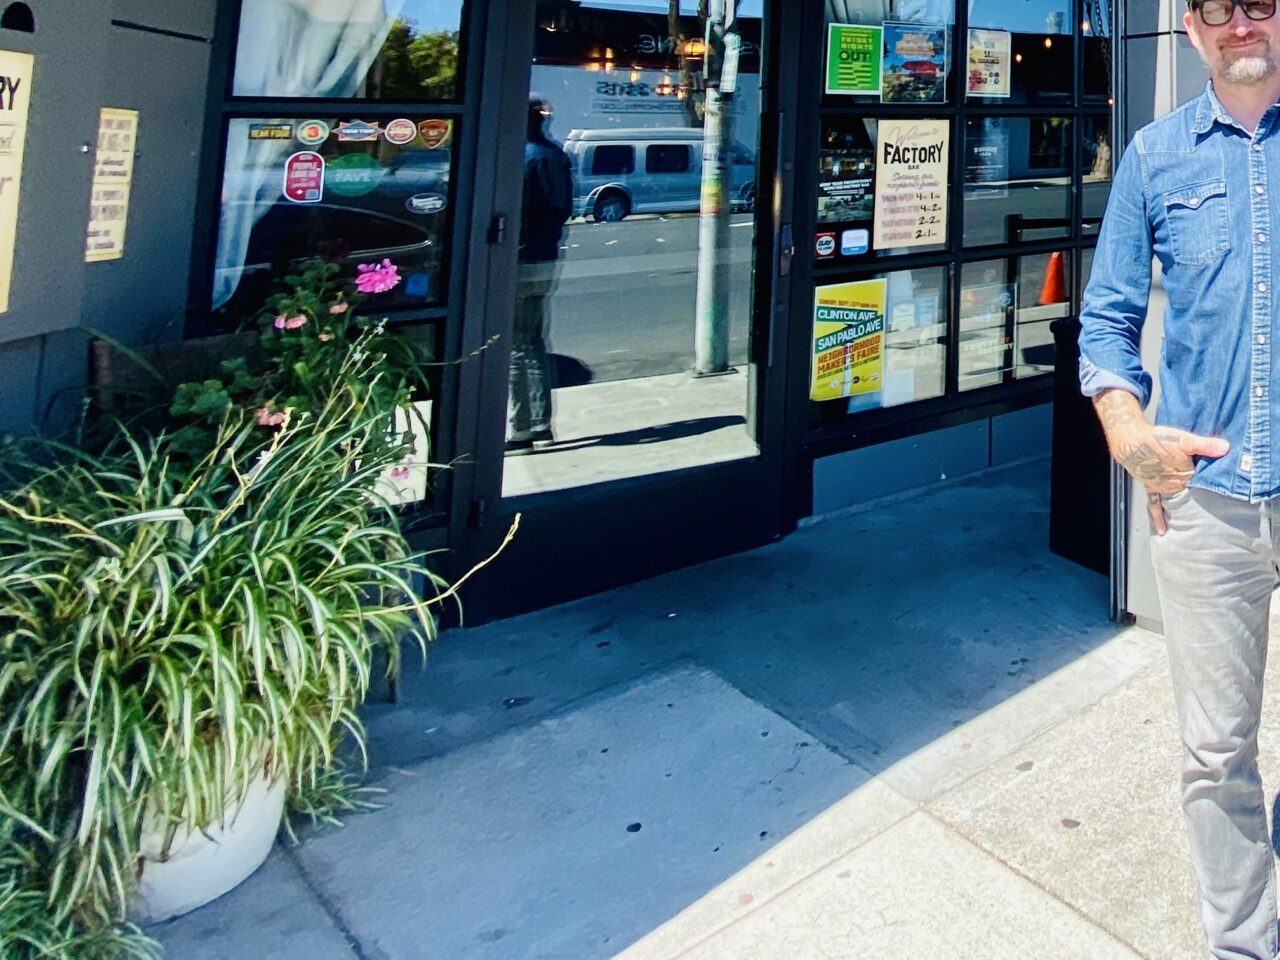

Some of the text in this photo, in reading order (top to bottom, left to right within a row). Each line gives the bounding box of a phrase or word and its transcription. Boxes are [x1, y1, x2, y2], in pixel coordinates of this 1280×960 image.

[884, 140, 944, 164] FACTORY
[818, 309, 876, 321] CLINTON AVE
[818, 319, 881, 350] SAN PABLO AVE
